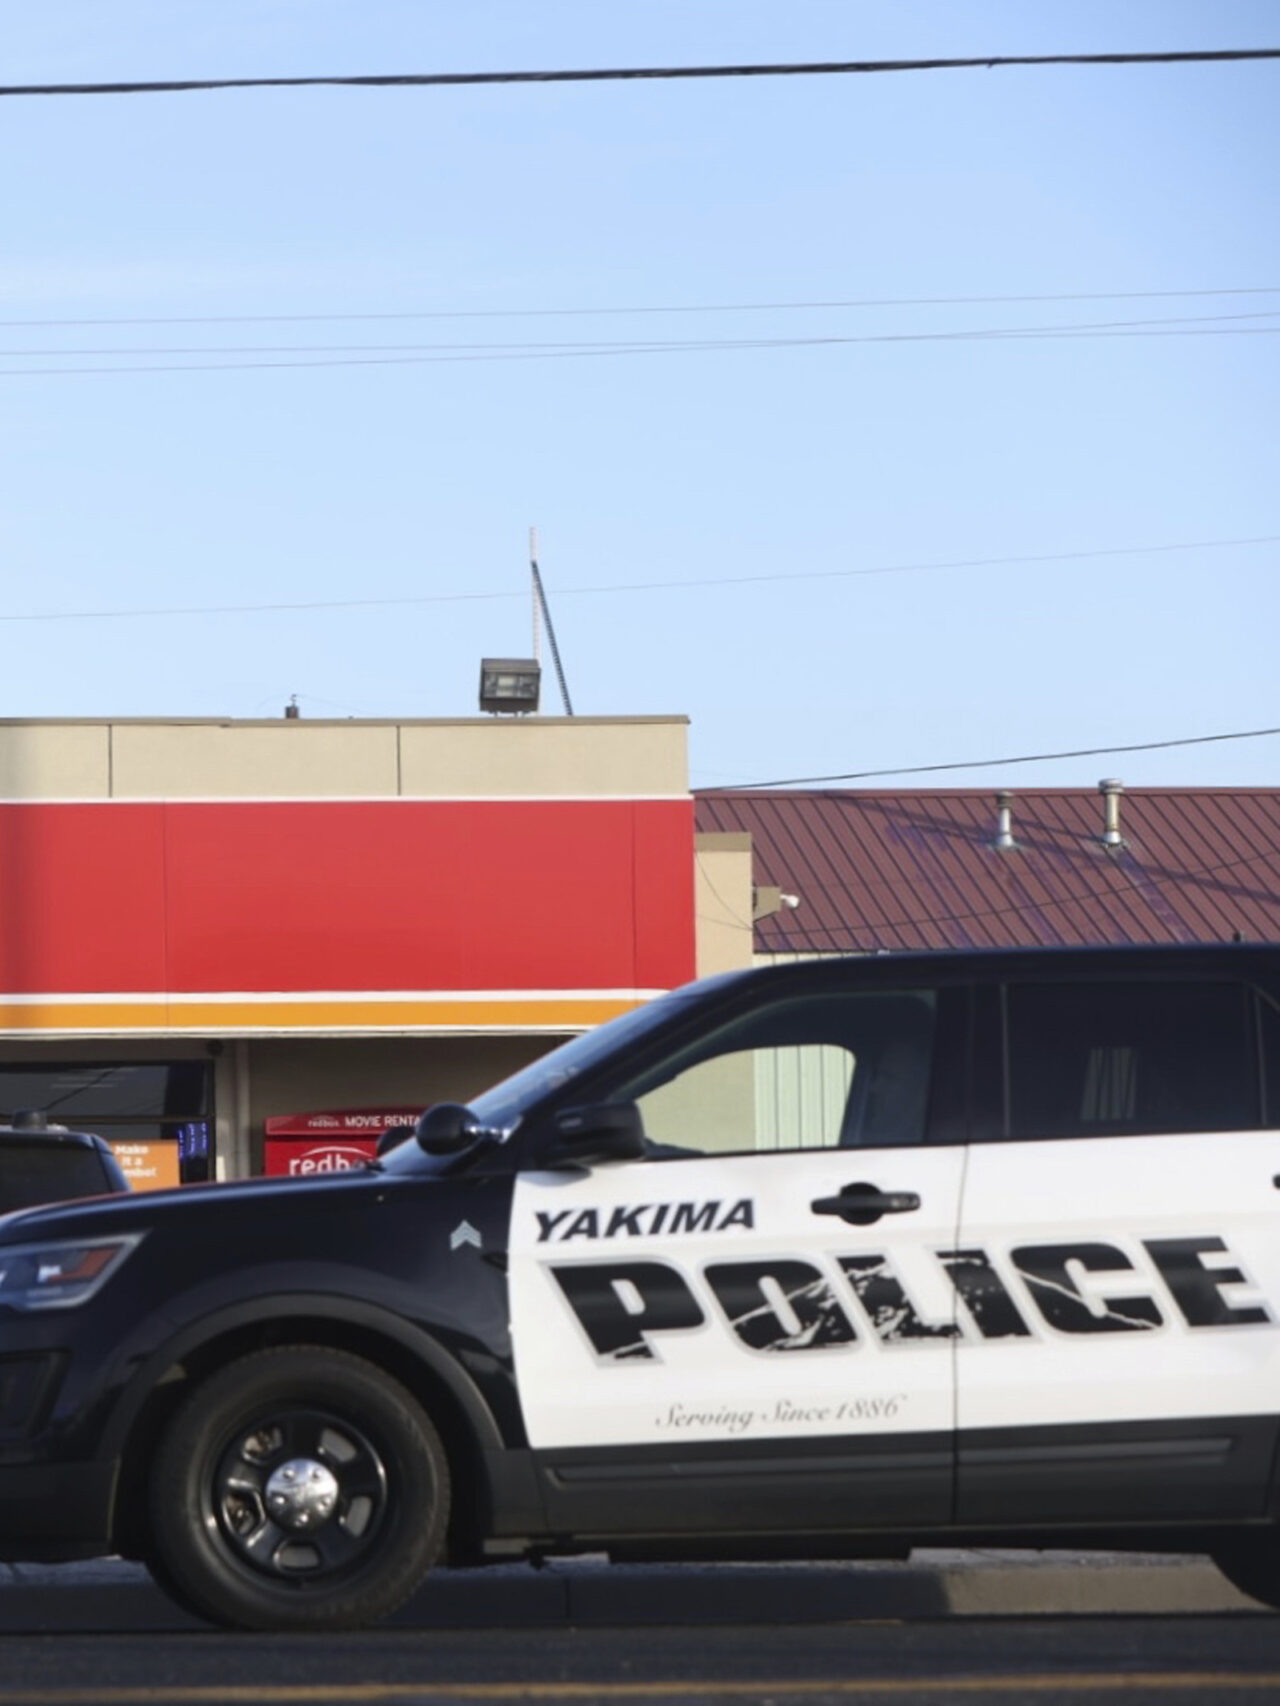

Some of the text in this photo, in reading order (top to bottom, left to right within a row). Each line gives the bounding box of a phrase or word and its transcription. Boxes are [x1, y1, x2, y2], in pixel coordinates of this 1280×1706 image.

[344, 1116, 381, 1127] MOVIE
[384, 1115, 421, 1127] RENTA
[534, 1197, 756, 1243] YAKIMA
[542, 1236, 1278, 1365] POLICE
[655, 1394, 907, 1433] Serving Since 1886
